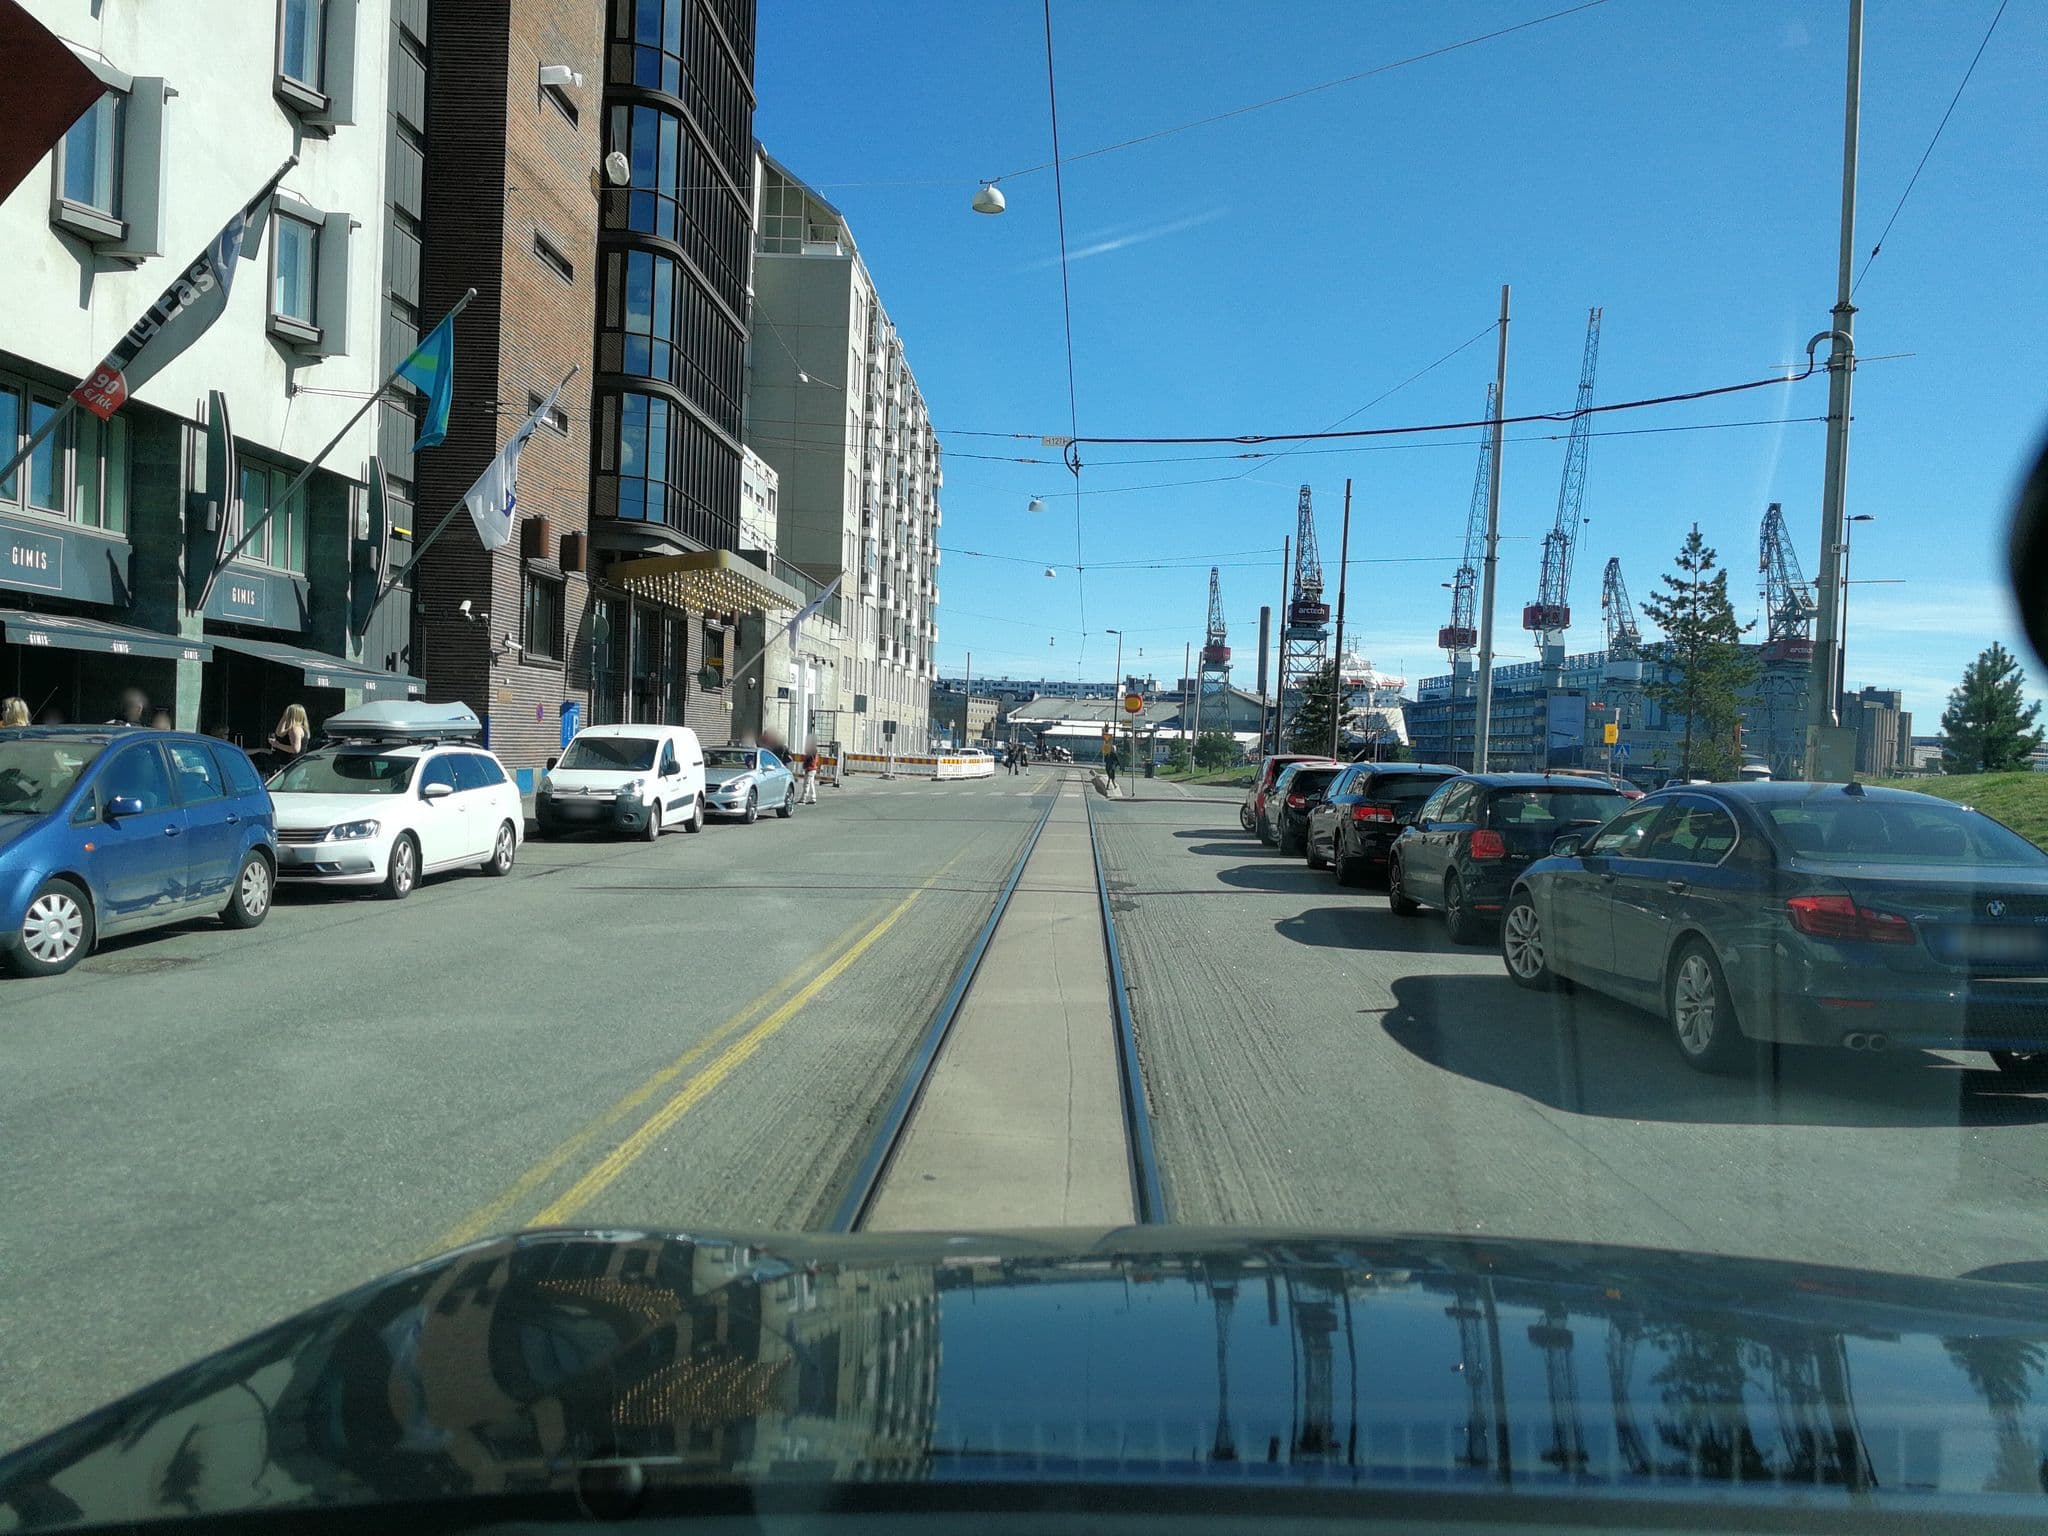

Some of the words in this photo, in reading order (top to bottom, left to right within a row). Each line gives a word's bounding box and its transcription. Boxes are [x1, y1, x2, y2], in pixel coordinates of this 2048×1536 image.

[12, 546, 47, 570] GIMIS
[232, 587, 255, 605] GIMIS
[1298, 607, 1325, 615] arctech
